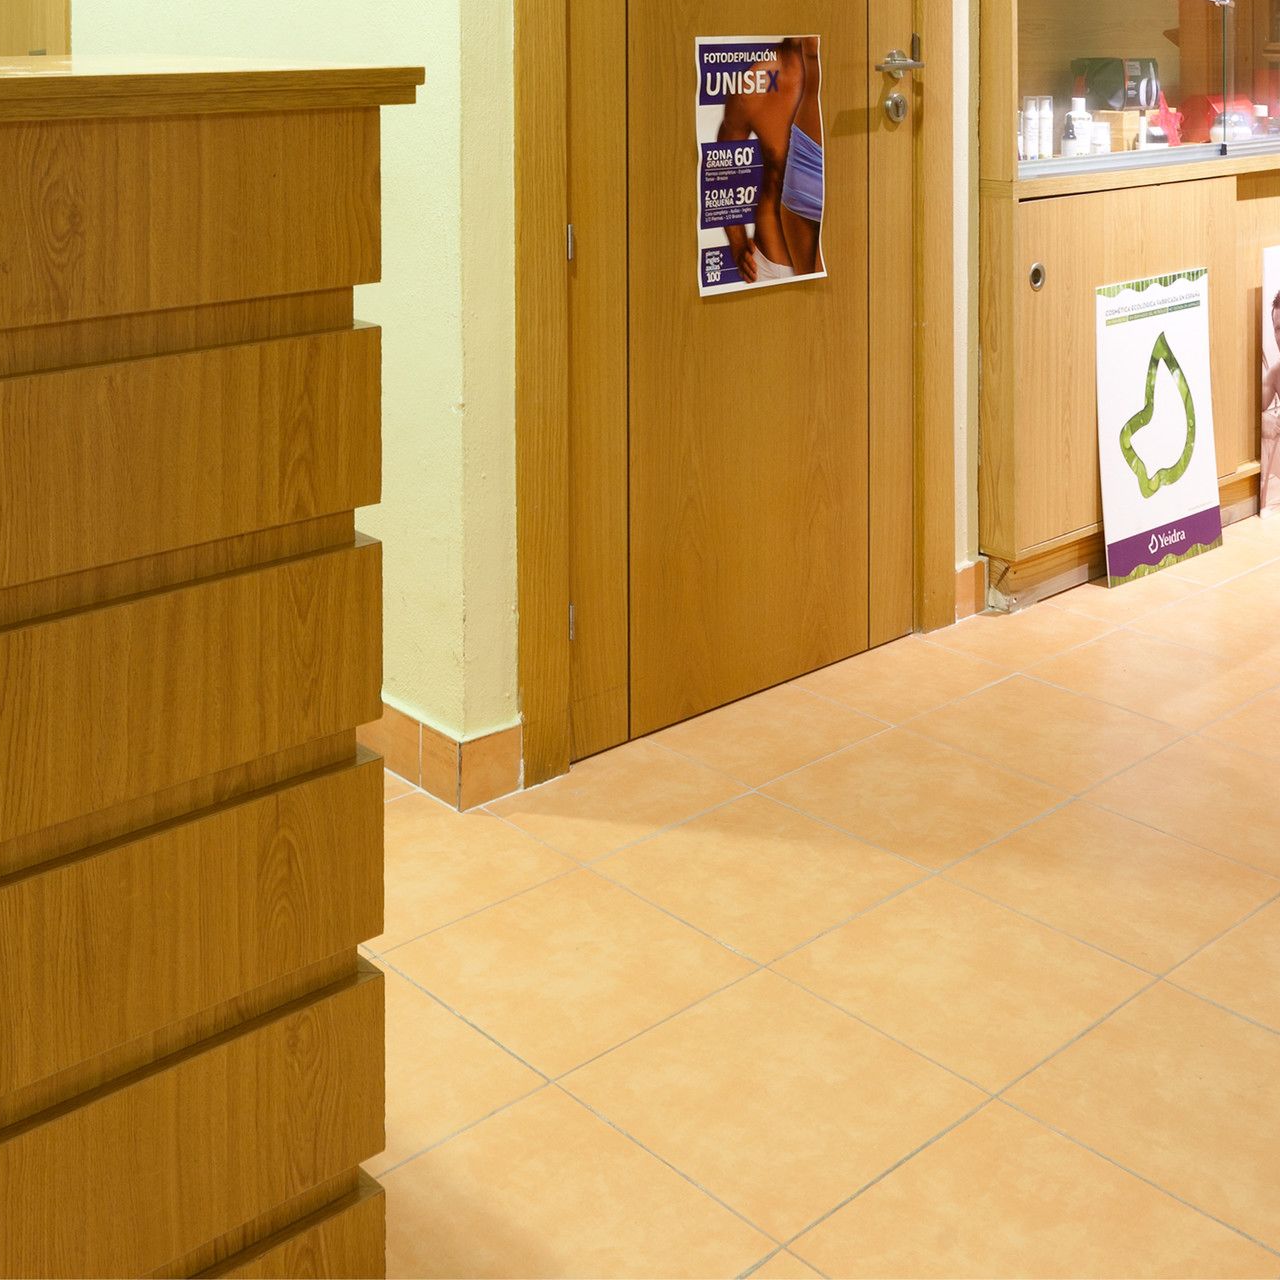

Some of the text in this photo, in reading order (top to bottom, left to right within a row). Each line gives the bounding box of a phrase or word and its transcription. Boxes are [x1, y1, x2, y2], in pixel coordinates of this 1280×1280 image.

[703, 48, 777, 64] FOTODEPILACIÓN
[706, 70, 780, 97] UNISEX
[706, 149, 733, 161] ZONA
[706, 159, 733, 169] GRANDE
[705, 188, 734, 201] ZONA
[1158, 528, 1186, 548] Yeidra
